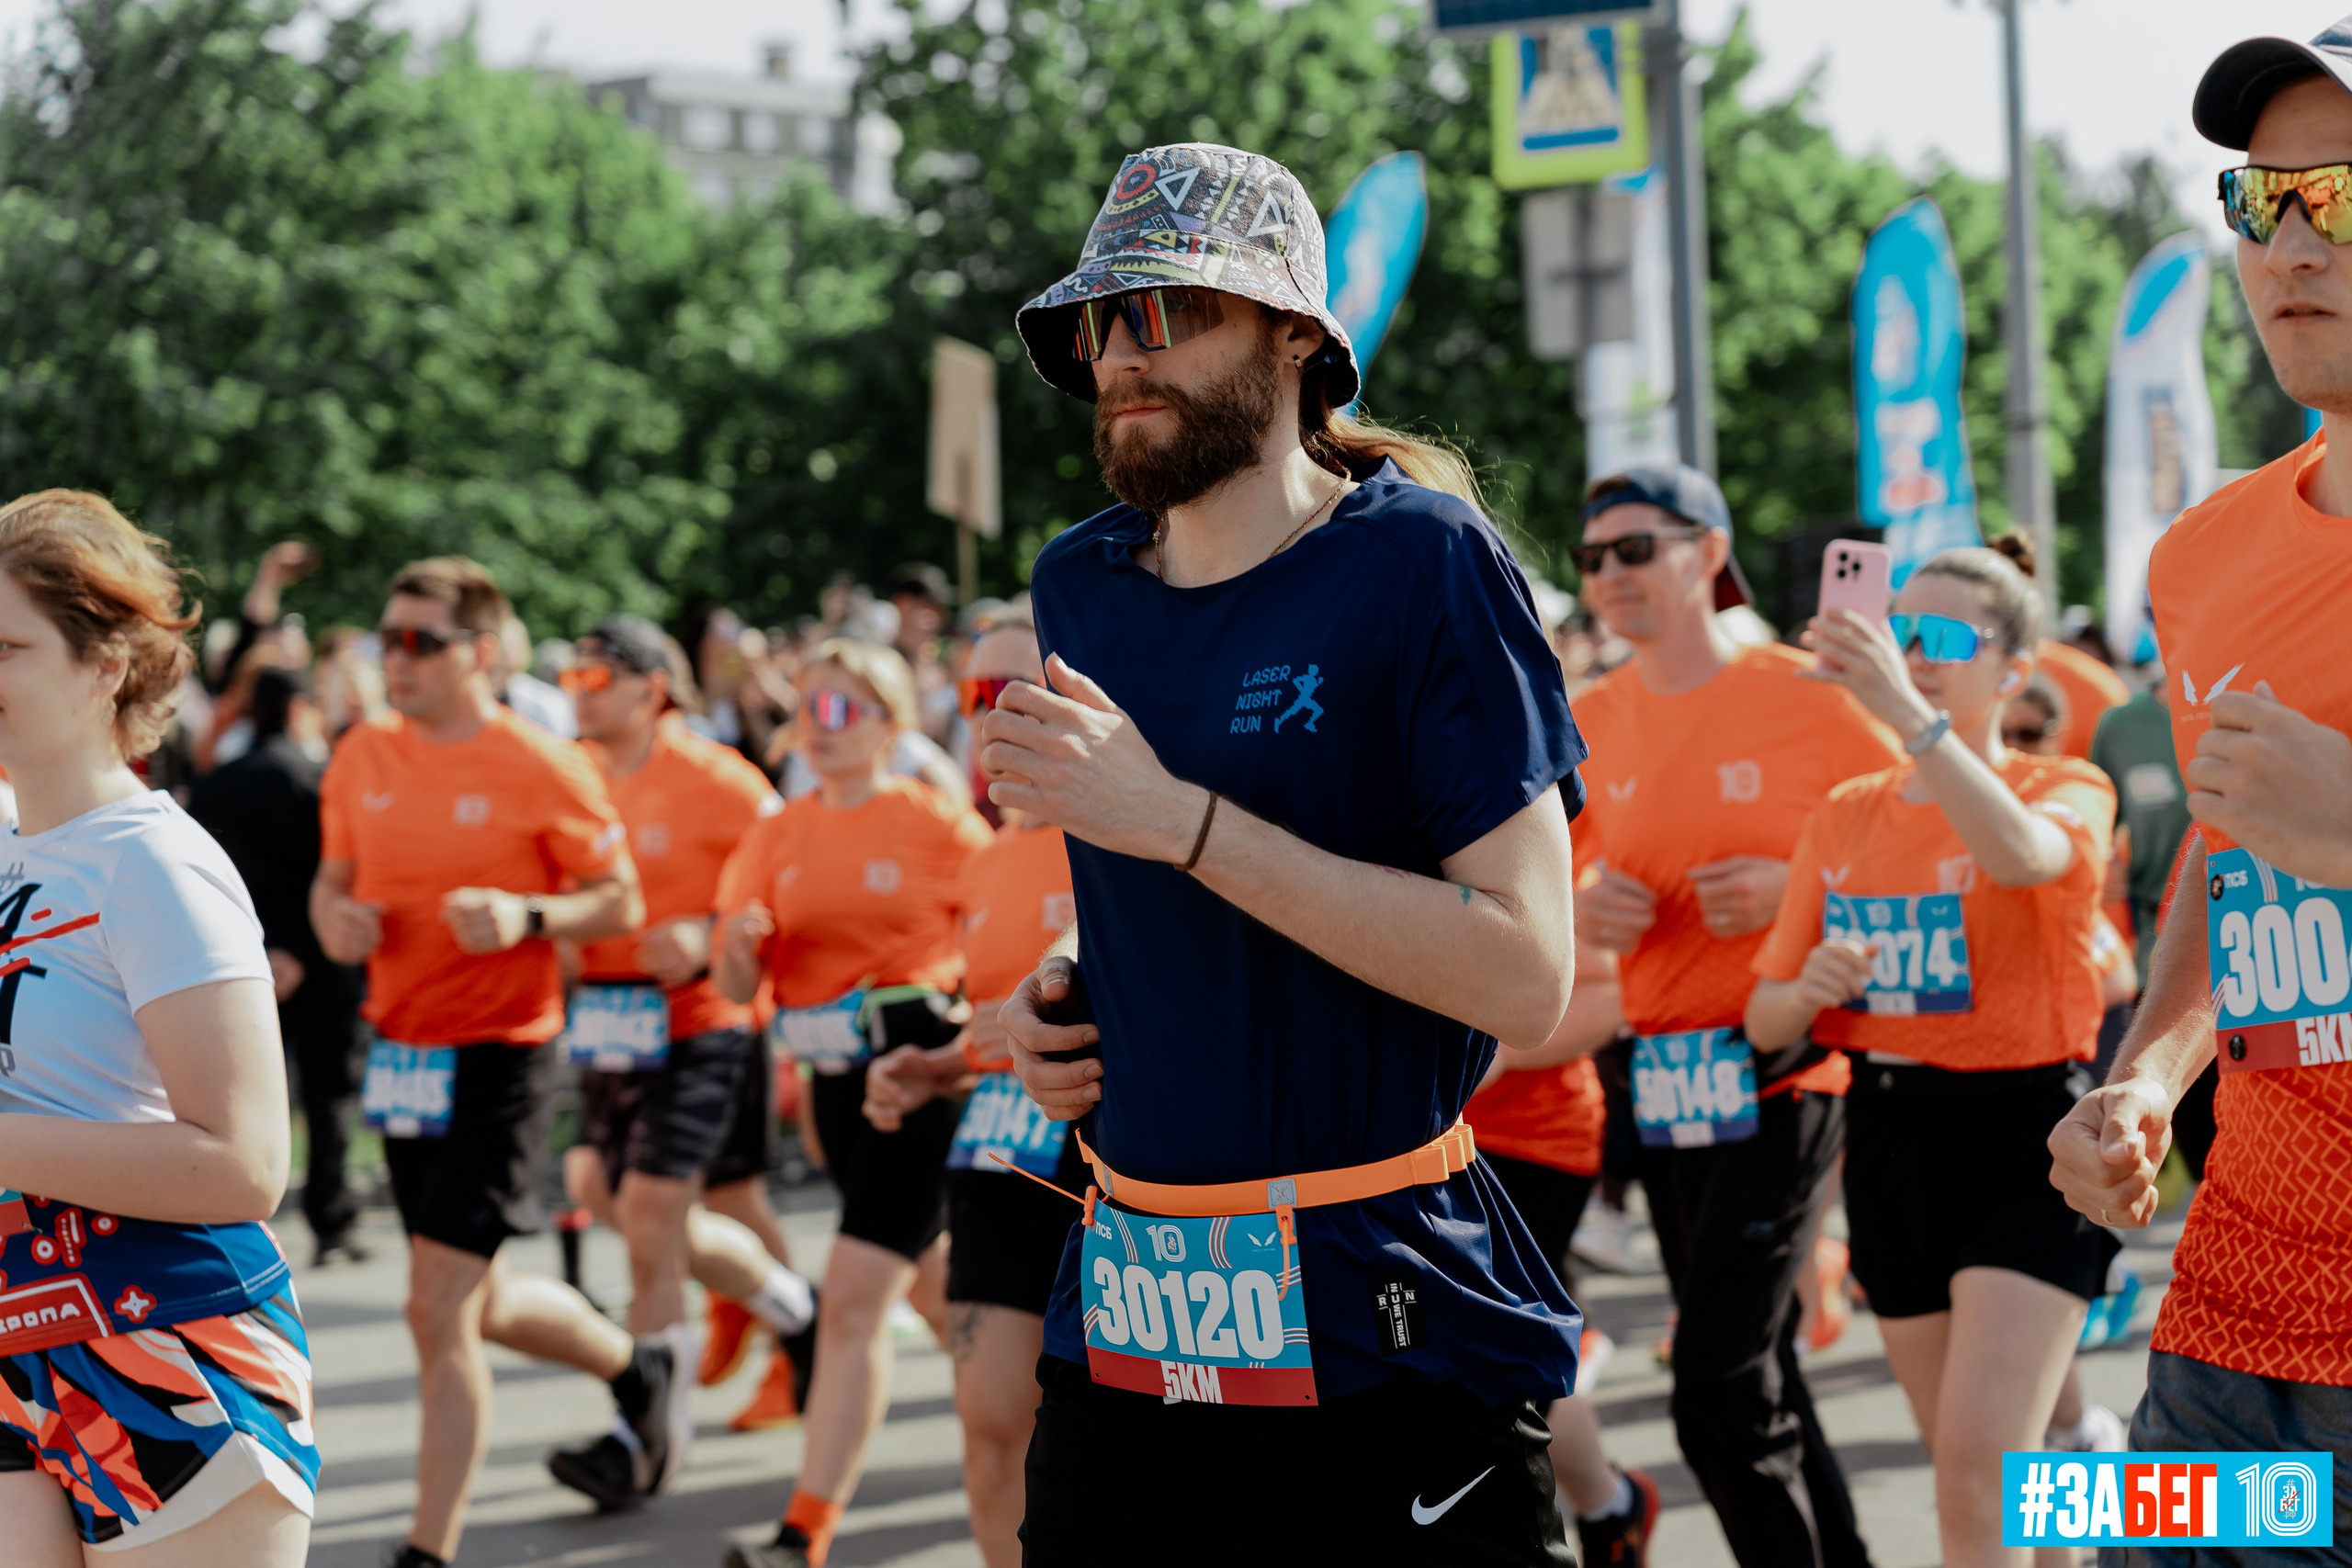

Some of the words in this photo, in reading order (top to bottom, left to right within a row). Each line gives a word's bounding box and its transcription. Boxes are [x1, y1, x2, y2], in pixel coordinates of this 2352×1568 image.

[1242, 665, 1291, 687] LASER
[1235, 689, 1282, 710] NIGHT
[1230, 715, 1261, 734] RUN
[1828, 926, 1959, 988] 074
[2220, 897, 2352, 1017] 300
[1095, 1221, 1113, 1240] ПСБ
[1145, 1224, 1187, 1263] 10
[1093, 1257, 1284, 1359] 30120
[1396, 1319, 1407, 1347] TRUST
[1160, 1360, 1224, 1404] 5KM
